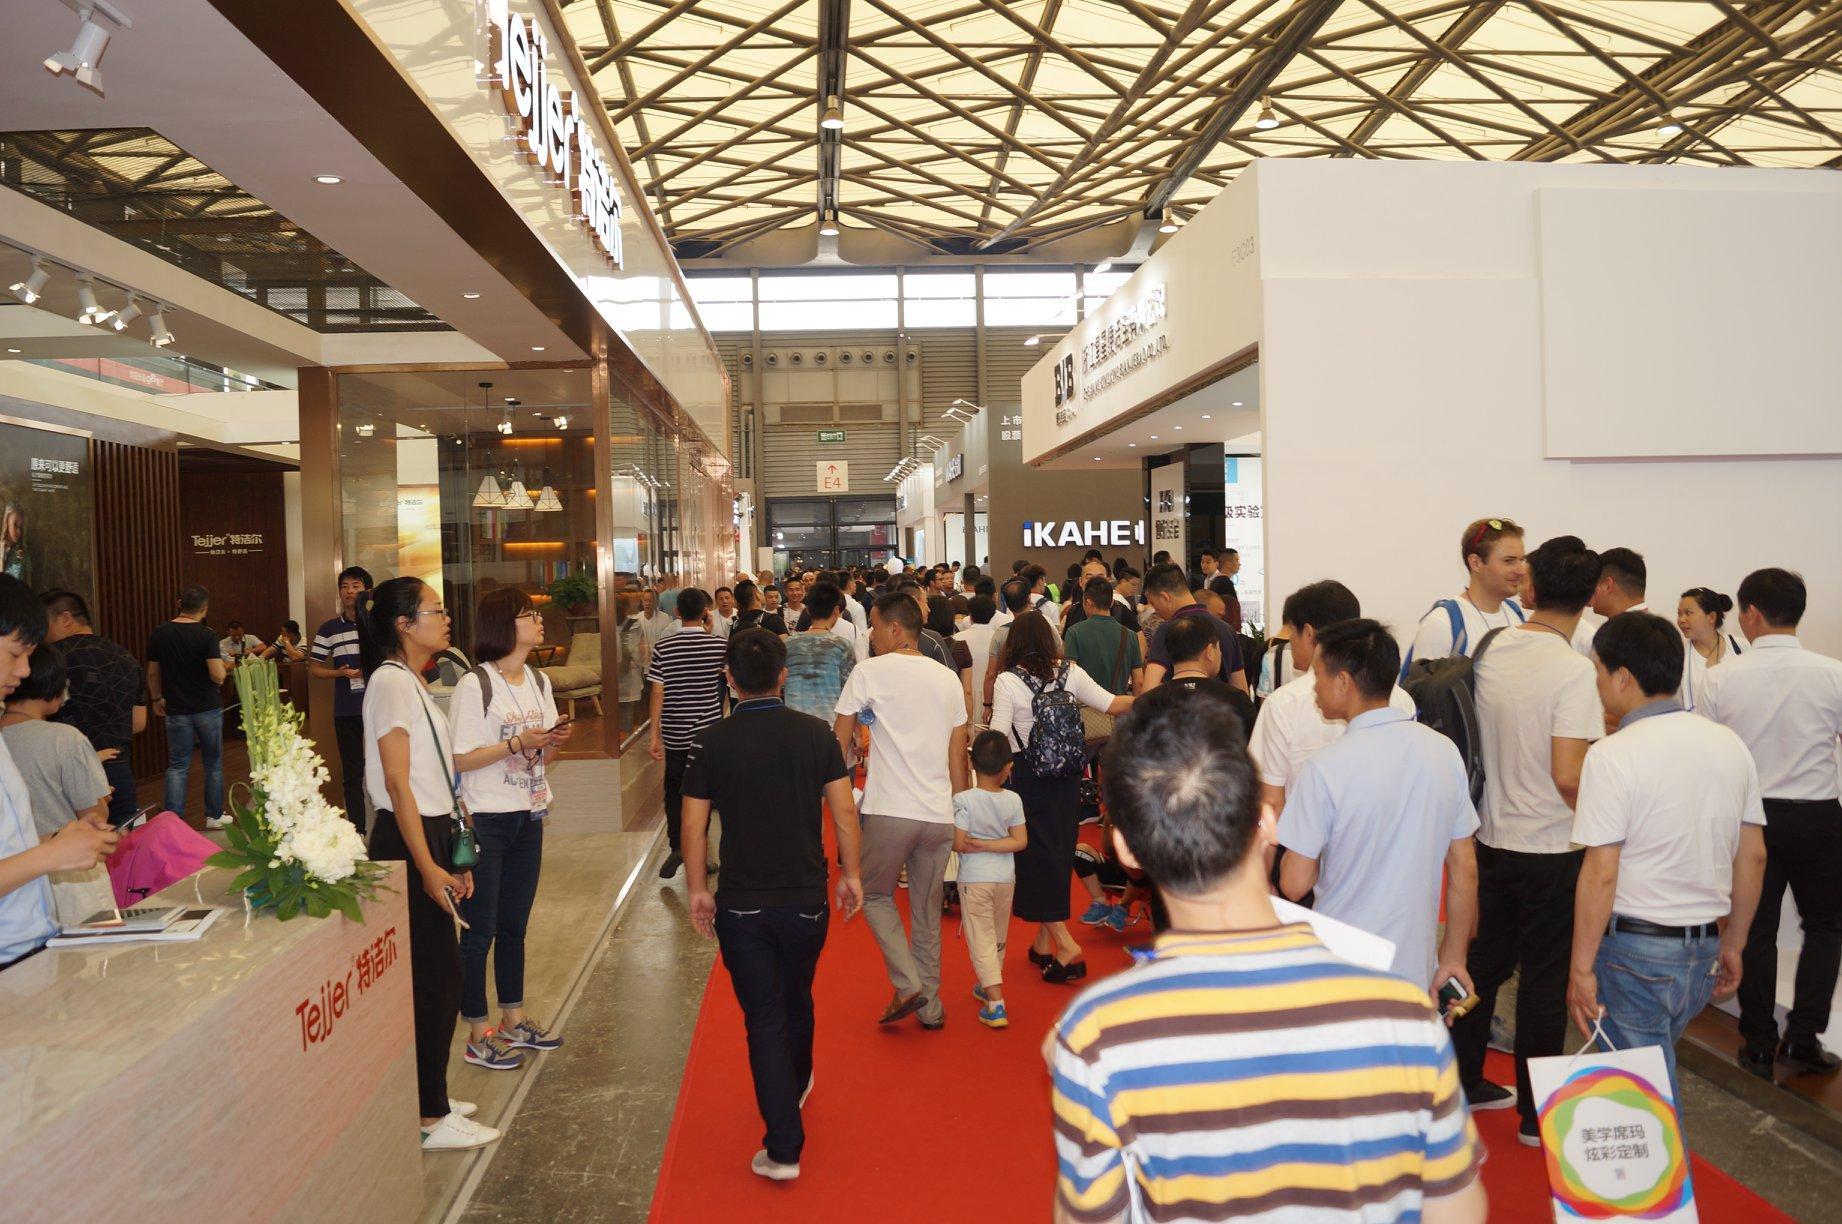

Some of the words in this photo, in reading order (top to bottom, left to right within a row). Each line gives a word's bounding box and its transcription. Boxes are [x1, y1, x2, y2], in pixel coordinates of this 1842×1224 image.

[1000, 415, 1023, 426] 上市
[824, 476, 841, 489] E4
[191, 534, 228, 548] Tejjer
[296, 970, 352, 1052] Tejjer
[356, 926, 397, 995] 特洁尔
[1582, 1124, 1646, 1143] 美学席玛
[1584, 1143, 1649, 1162] 炫彩定制
